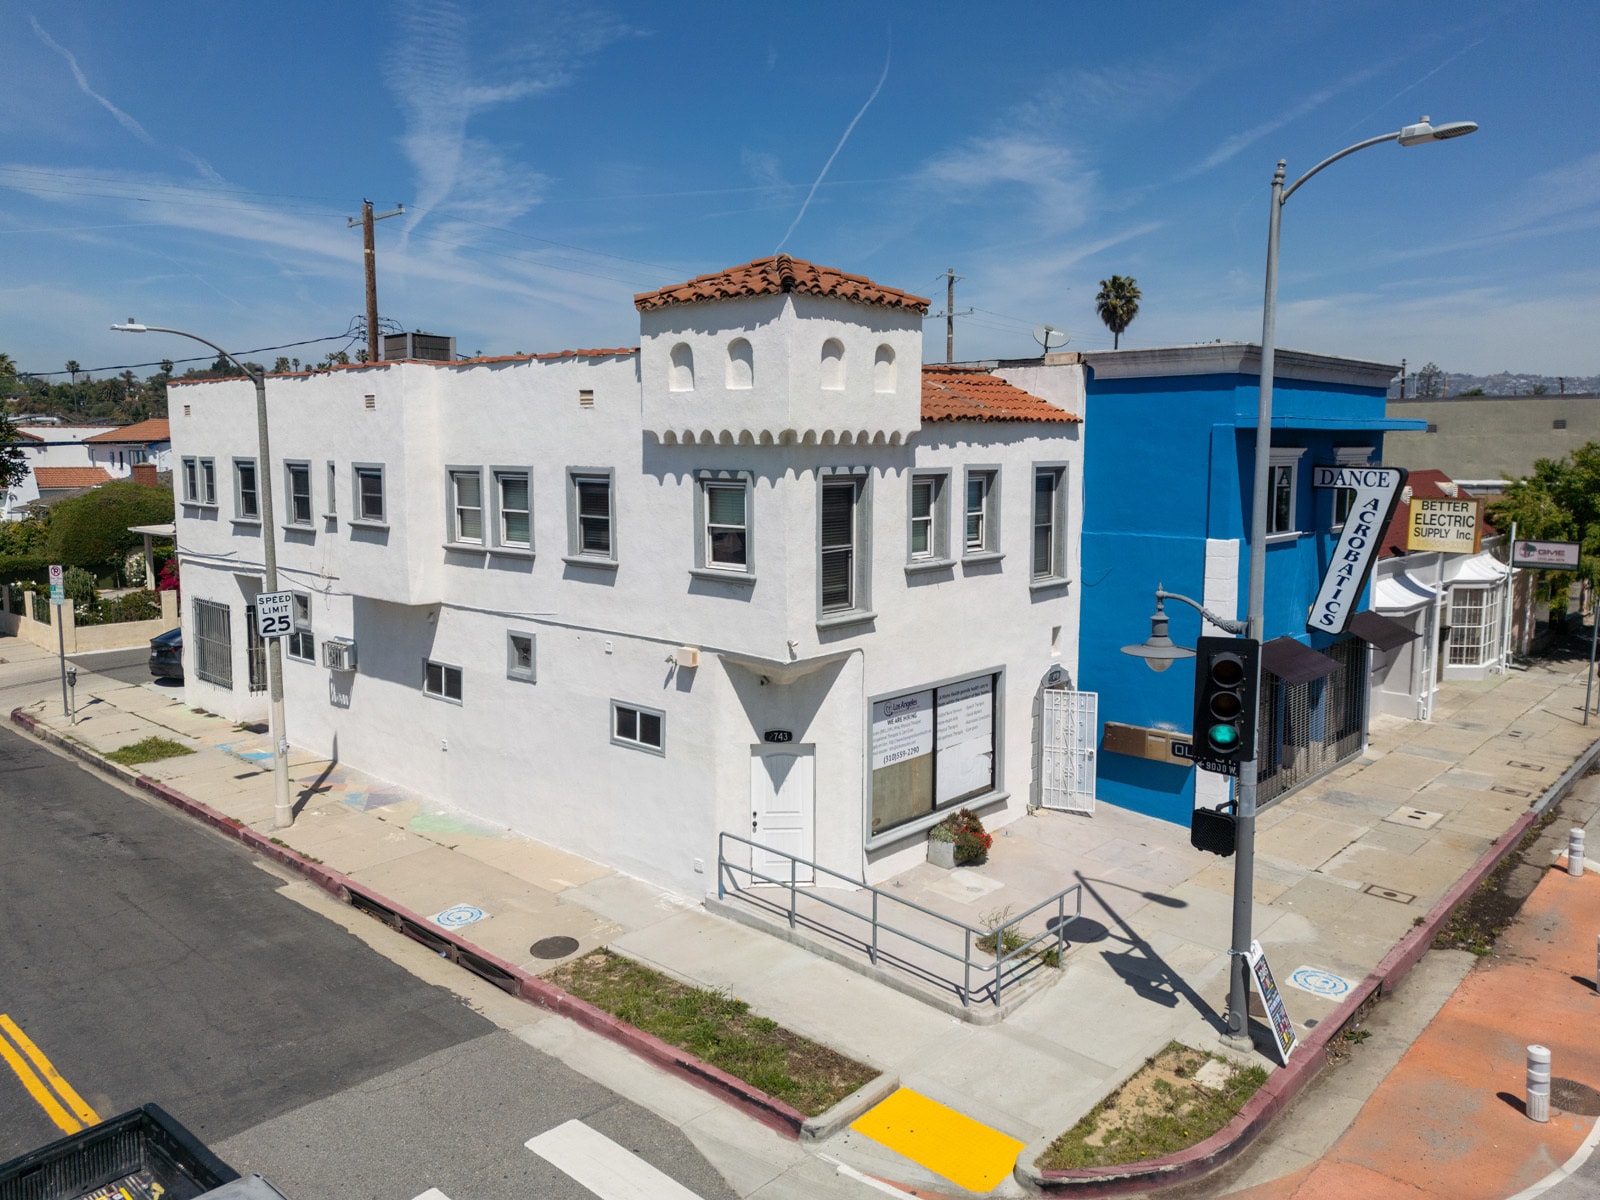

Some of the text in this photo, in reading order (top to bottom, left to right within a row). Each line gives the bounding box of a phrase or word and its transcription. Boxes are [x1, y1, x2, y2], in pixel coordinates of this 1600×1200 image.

[1320, 469, 1390, 488] DANCE
[1421, 500, 1469, 512] BETTER
[1414, 513, 1475, 528] ELECTRIC
[1413, 527, 1473, 541] SUPPLY Inc.
[1320, 498, 1380, 626] ACROBATICS
[258, 595, 291, 605] SPEED
[262, 605, 289, 615] LIMIT
[262, 615, 291, 633] 25
